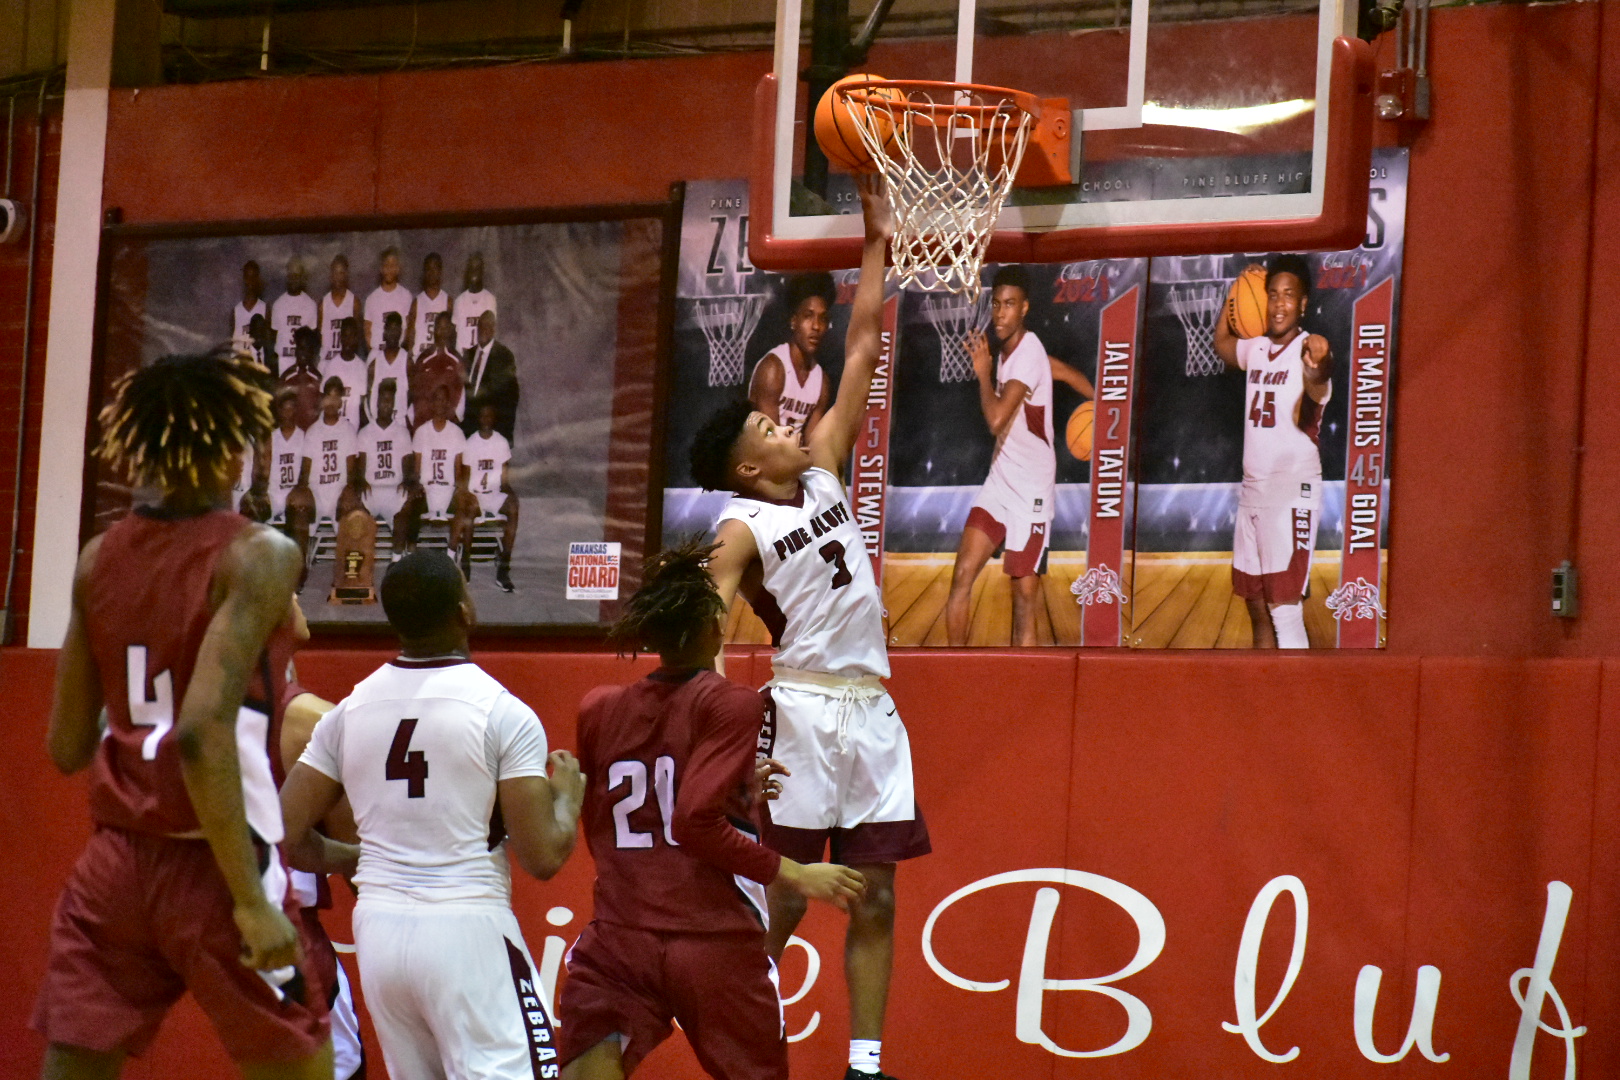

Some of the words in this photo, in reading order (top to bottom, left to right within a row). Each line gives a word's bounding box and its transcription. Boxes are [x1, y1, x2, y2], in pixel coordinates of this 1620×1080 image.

[1082, 179, 1132, 192] CHOOL
[1183, 176, 1215, 188] PINE
[1225, 173, 1269, 186] BLUFF
[710, 198, 742, 209] PINE
[1101, 340, 1130, 401] JALEN
[1354, 324, 1386, 447] DE'MARCUS
[1106, 407, 1121, 440] 2
[1248, 390, 1276, 428] 45
[867, 416, 881, 449] 5
[280, 466, 294, 484] 20
[322, 453, 338, 473] 33
[377, 453, 393, 470] 30
[432, 462, 445, 480] 15
[1350, 453, 1381, 487] 45
[1096, 445, 1125, 518] TATUM
[858, 454, 884, 557] STEWART
[772, 527, 812, 561] PINE
[809, 501, 850, 538] BLUFF
[1295, 508, 1311, 551] ZEBR
[1349, 493, 1377, 554] GOAL
[569, 554, 608, 566] NATIONAL
[570, 543, 608, 555] ARKANSAS
[568, 566, 618, 588] GUARD
[127, 645, 173, 761] 4
[385, 718, 429, 799] 4
[922, 867, 1587, 1080] Bluf
[519, 978, 559, 1079] ZEBRAS
